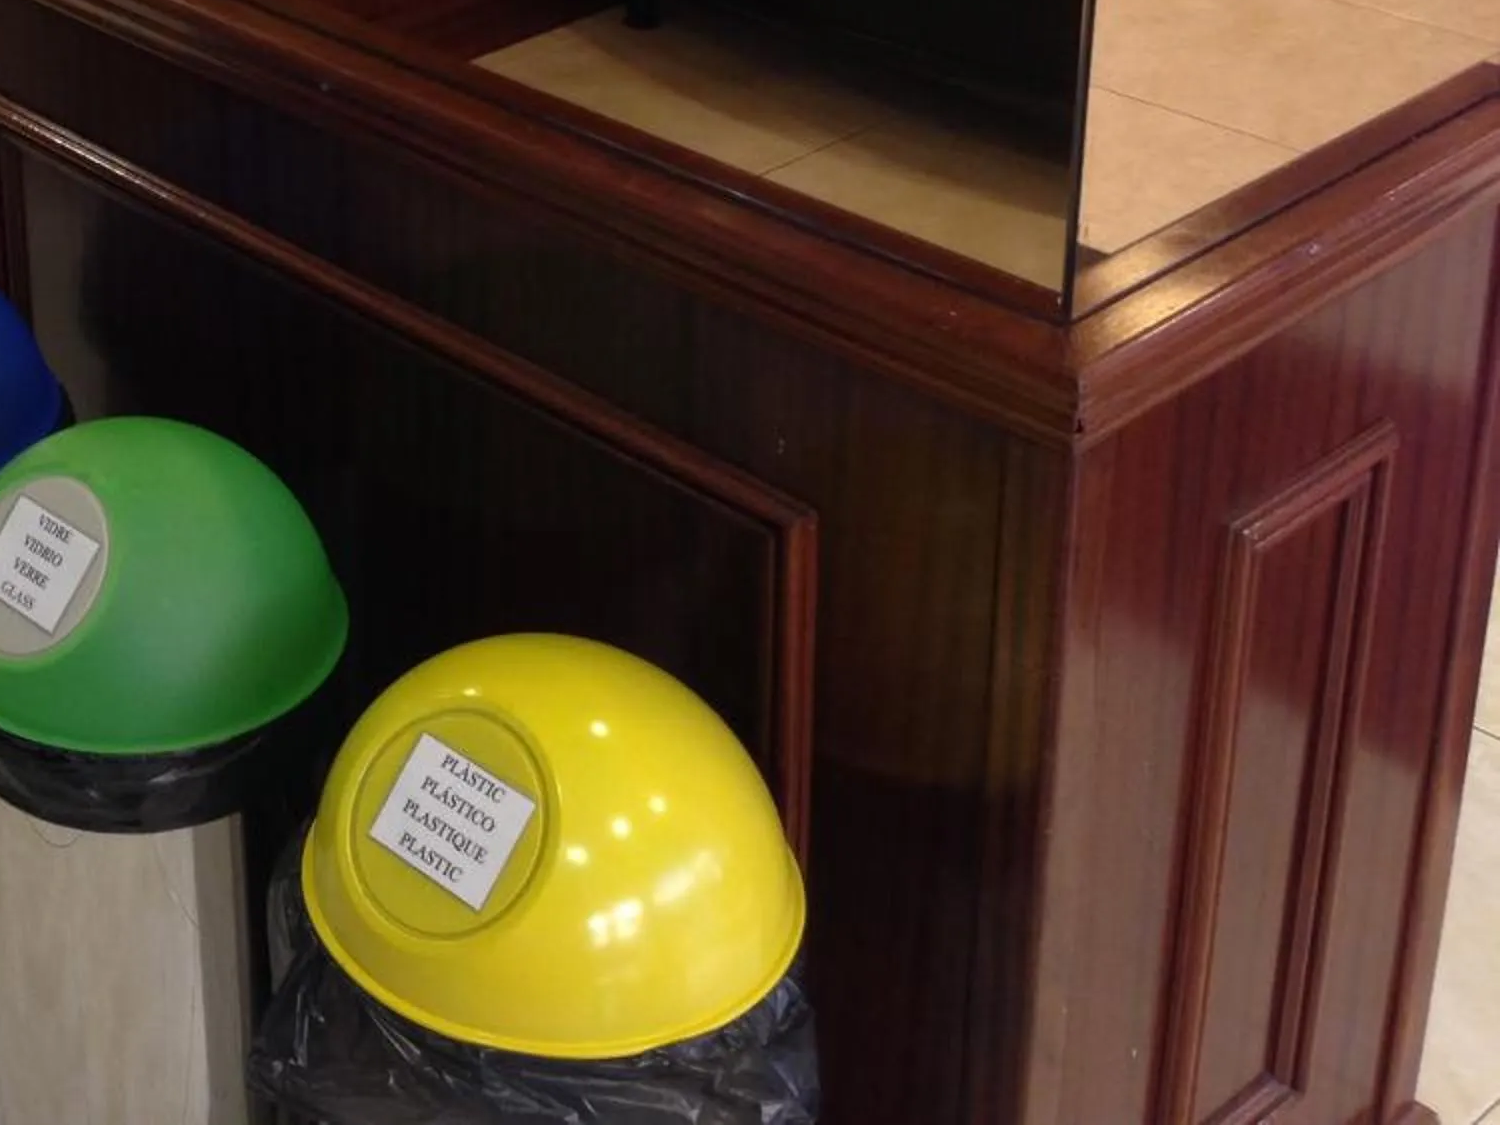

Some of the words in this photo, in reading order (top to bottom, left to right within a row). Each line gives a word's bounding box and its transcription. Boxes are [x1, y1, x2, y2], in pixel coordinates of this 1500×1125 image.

[38, 513, 74, 543] VIDRE
[25, 534, 63, 567] VIDRIO
[13, 556, 51, 589] VERRE
[1, 581, 36, 610] GLASS
[420, 776, 496, 833] PLÁSTICO
[402, 798, 488, 864] PLASTIQUE
[398, 832, 463, 883] PLASTIC
